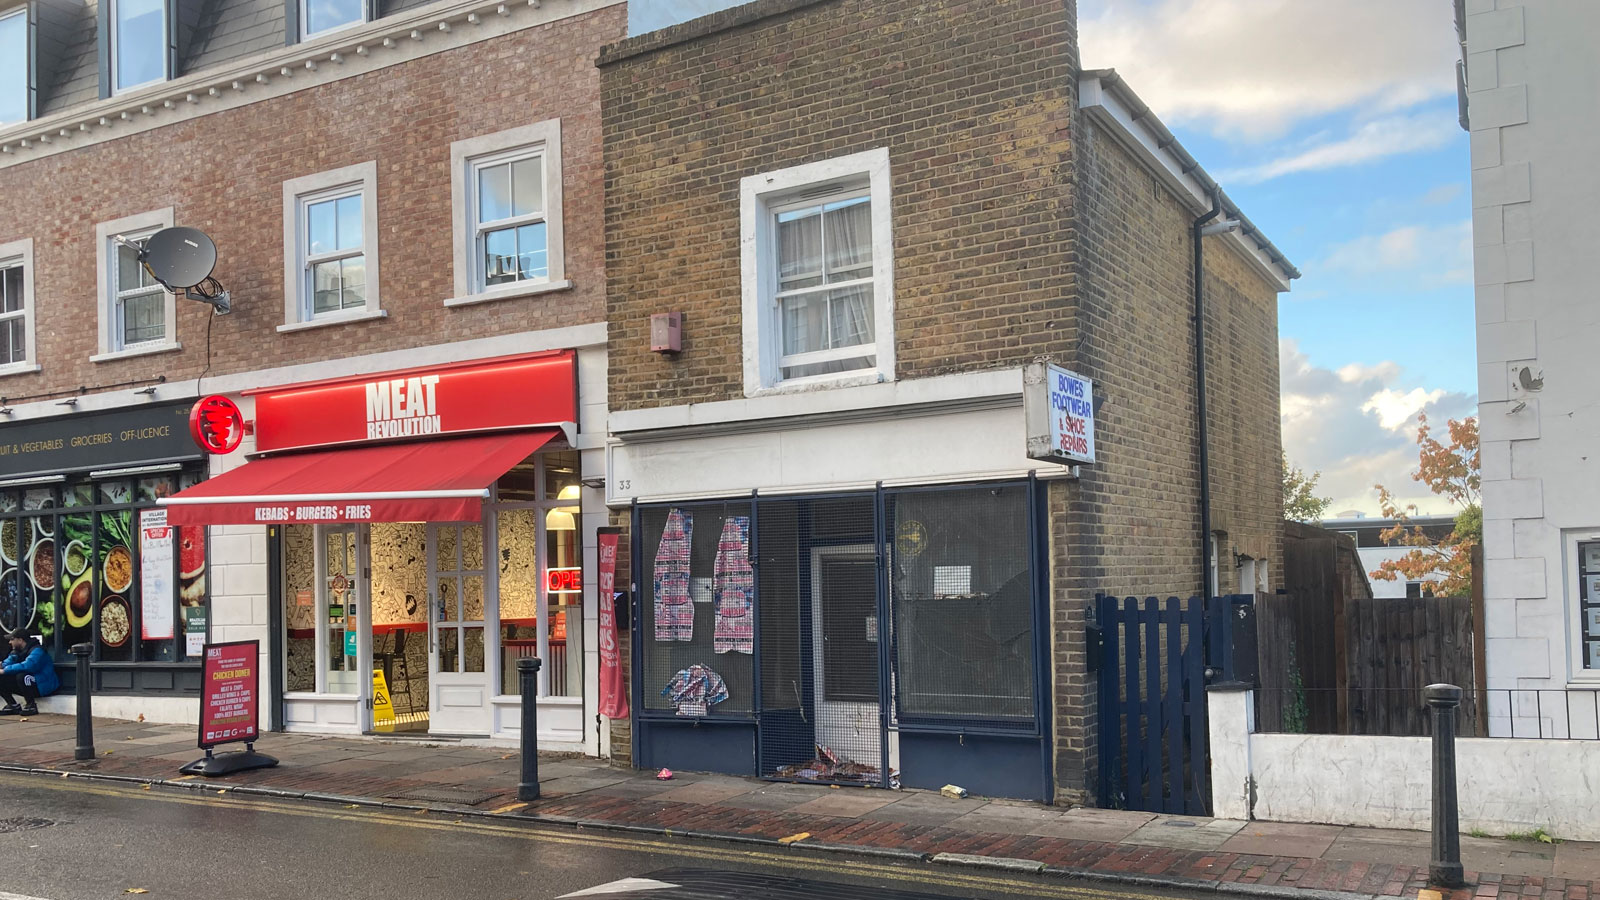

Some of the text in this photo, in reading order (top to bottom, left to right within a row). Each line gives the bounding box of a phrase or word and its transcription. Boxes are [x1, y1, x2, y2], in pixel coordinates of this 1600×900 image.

[1058, 374, 1084, 398] BOWES
[365, 375, 440, 422] MEAT
[1052, 391, 1092, 418] FOOTWEAR
[367, 415, 440, 439] REVOLUTION
[1059, 415, 1086, 436] & SHOE
[0, 426, 170, 456] UIT & VEGETABLES GROCERIES OFF-LICENCE
[1060, 433, 1088, 455] REPAIRS
[619, 479, 632, 491] 33
[255, 505, 372, 520] KEBABS BURGERS FRIES
[549, 570, 581, 590] OPE
[207, 648, 222, 657] MEAT
[213, 670, 235, 680] CHICKEN
